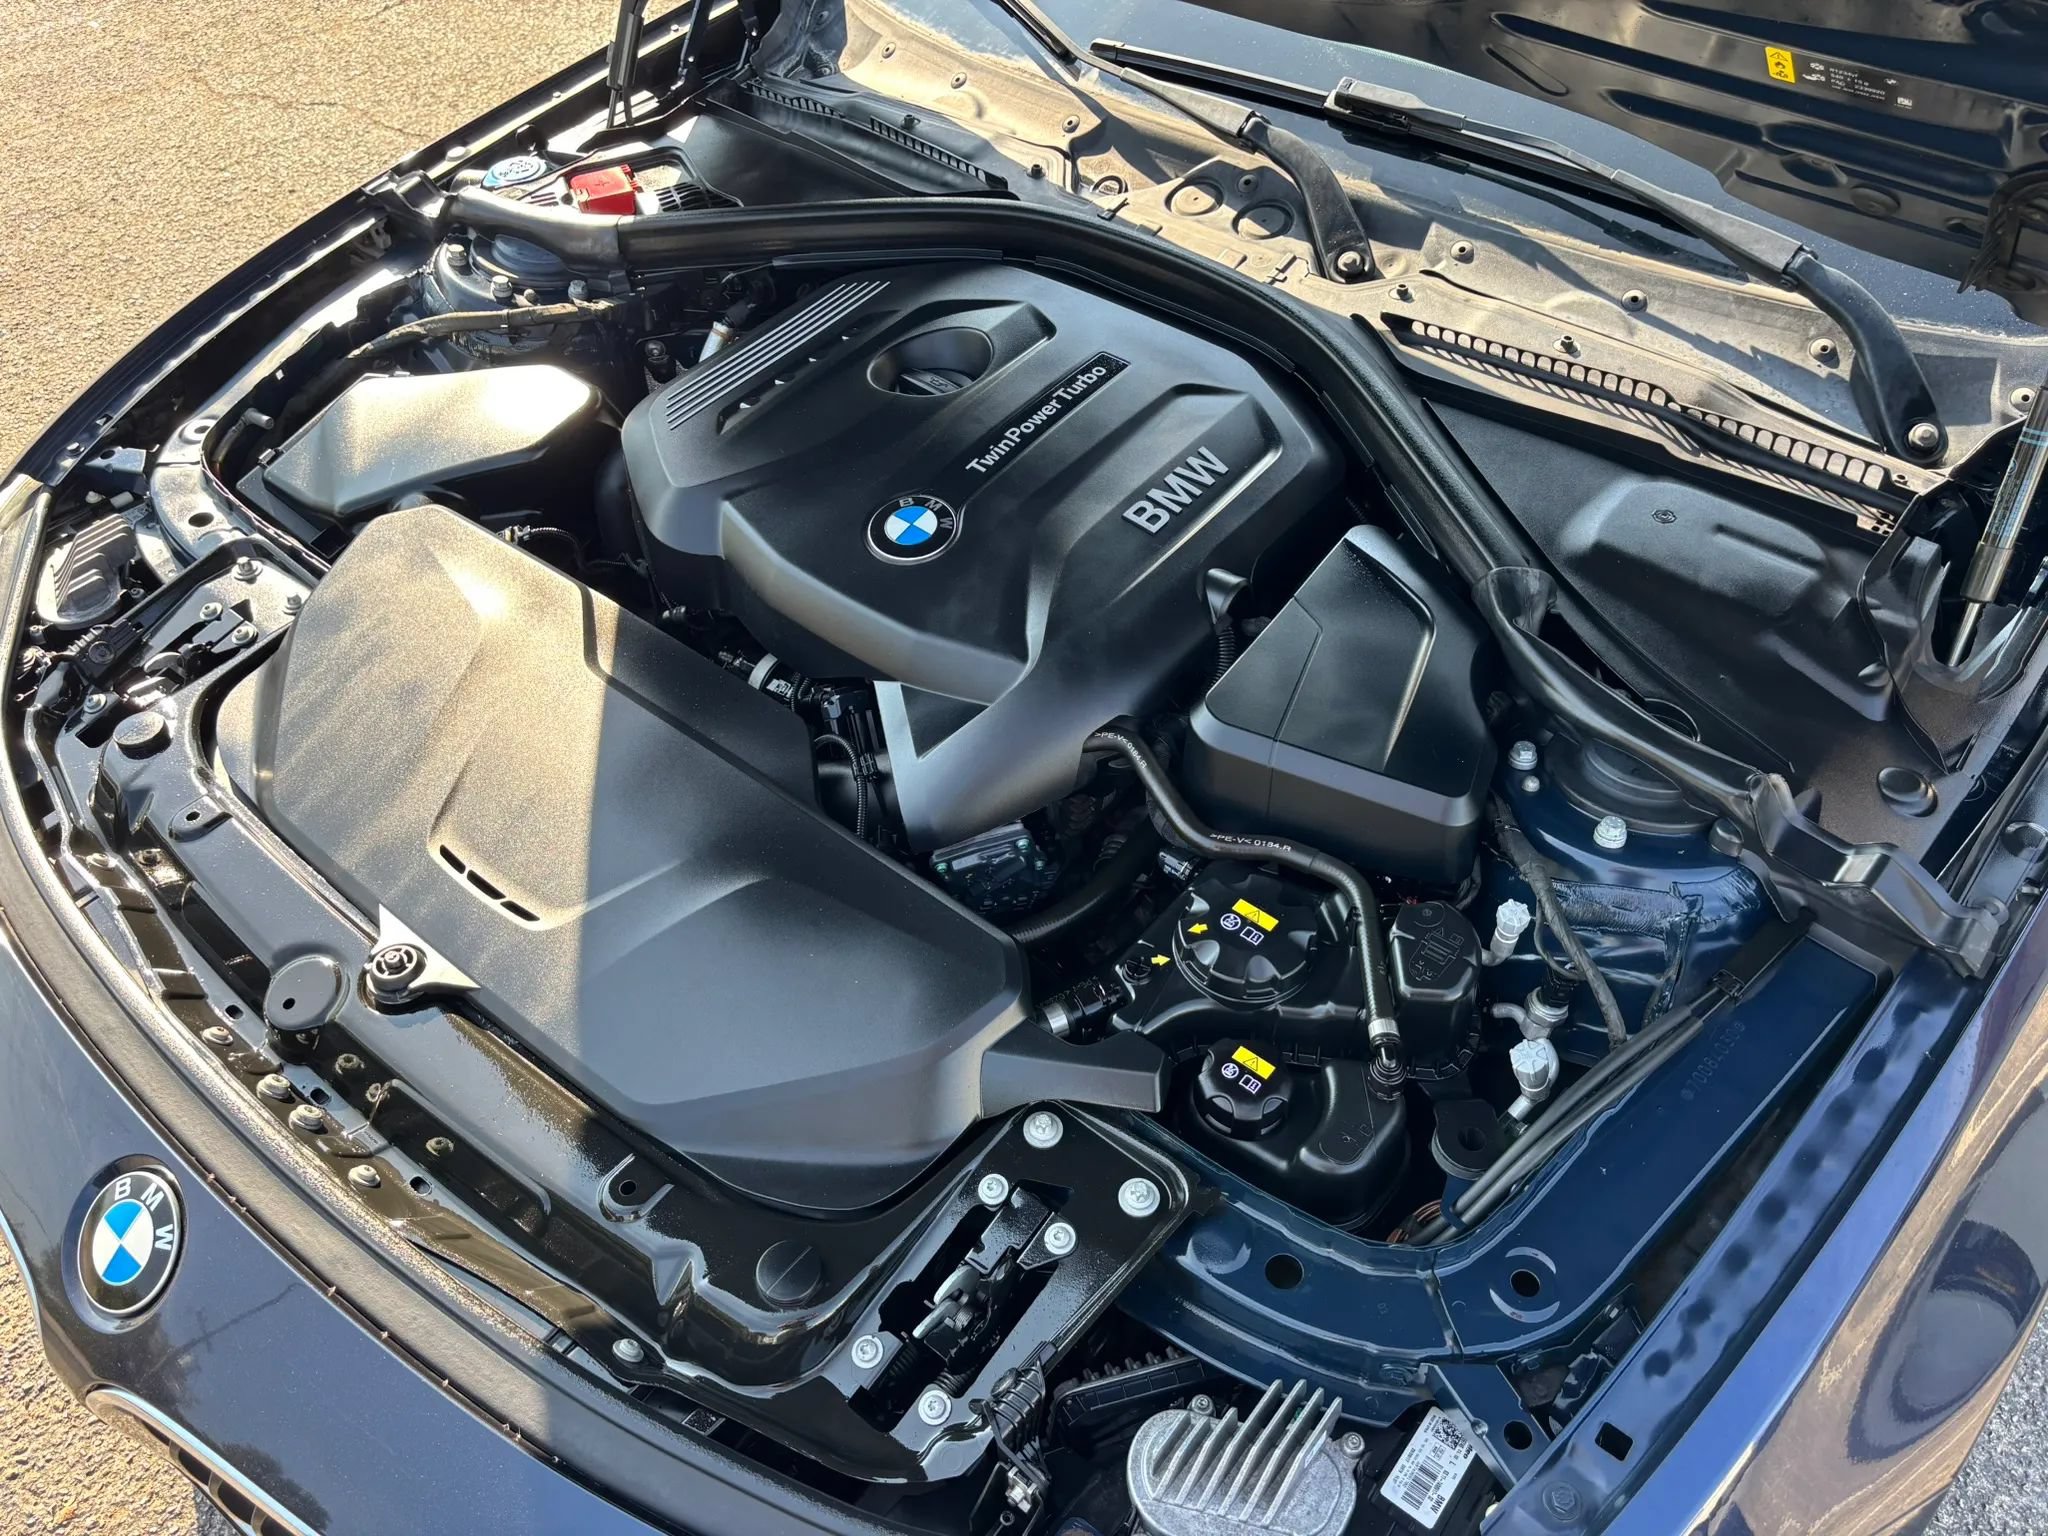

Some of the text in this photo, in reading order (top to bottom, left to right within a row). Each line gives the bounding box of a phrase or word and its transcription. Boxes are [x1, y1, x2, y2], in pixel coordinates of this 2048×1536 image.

[965, 366, 1107, 473] TwinPower Turbo
[898, 497, 953, 529] BMW
[1122, 446, 1230, 534] BMW
[114, 1176, 175, 1252] BMW
[1430, 1494, 1446, 1515] BMW
